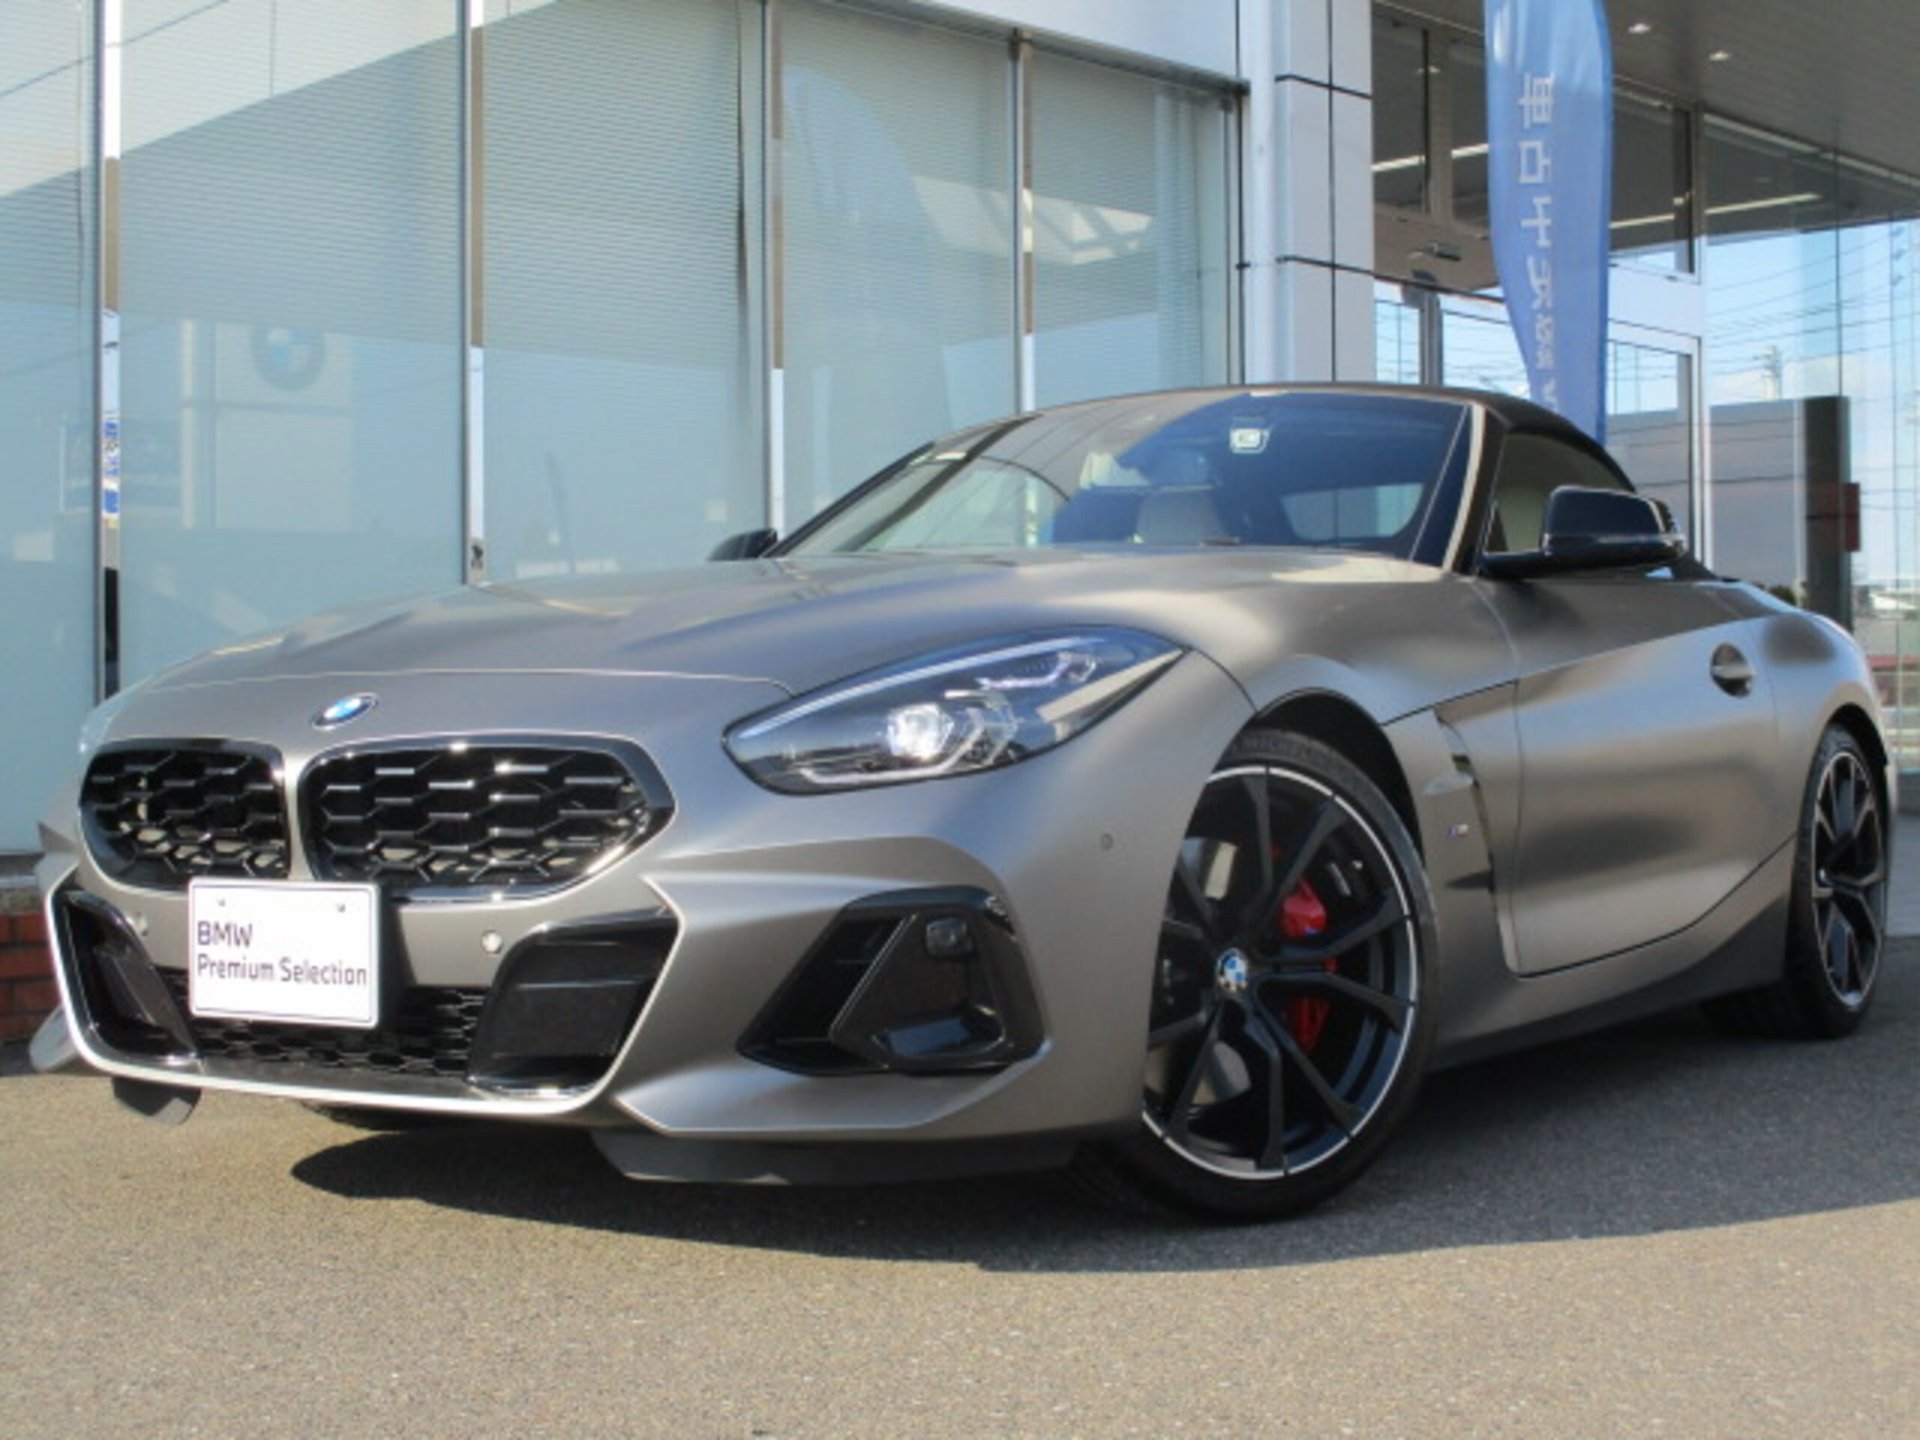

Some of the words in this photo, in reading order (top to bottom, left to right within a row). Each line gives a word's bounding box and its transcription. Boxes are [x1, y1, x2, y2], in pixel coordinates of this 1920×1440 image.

[197, 920, 253, 947] BMW
[197, 953, 275, 981] Premium
[279, 956, 367, 986] Selection
